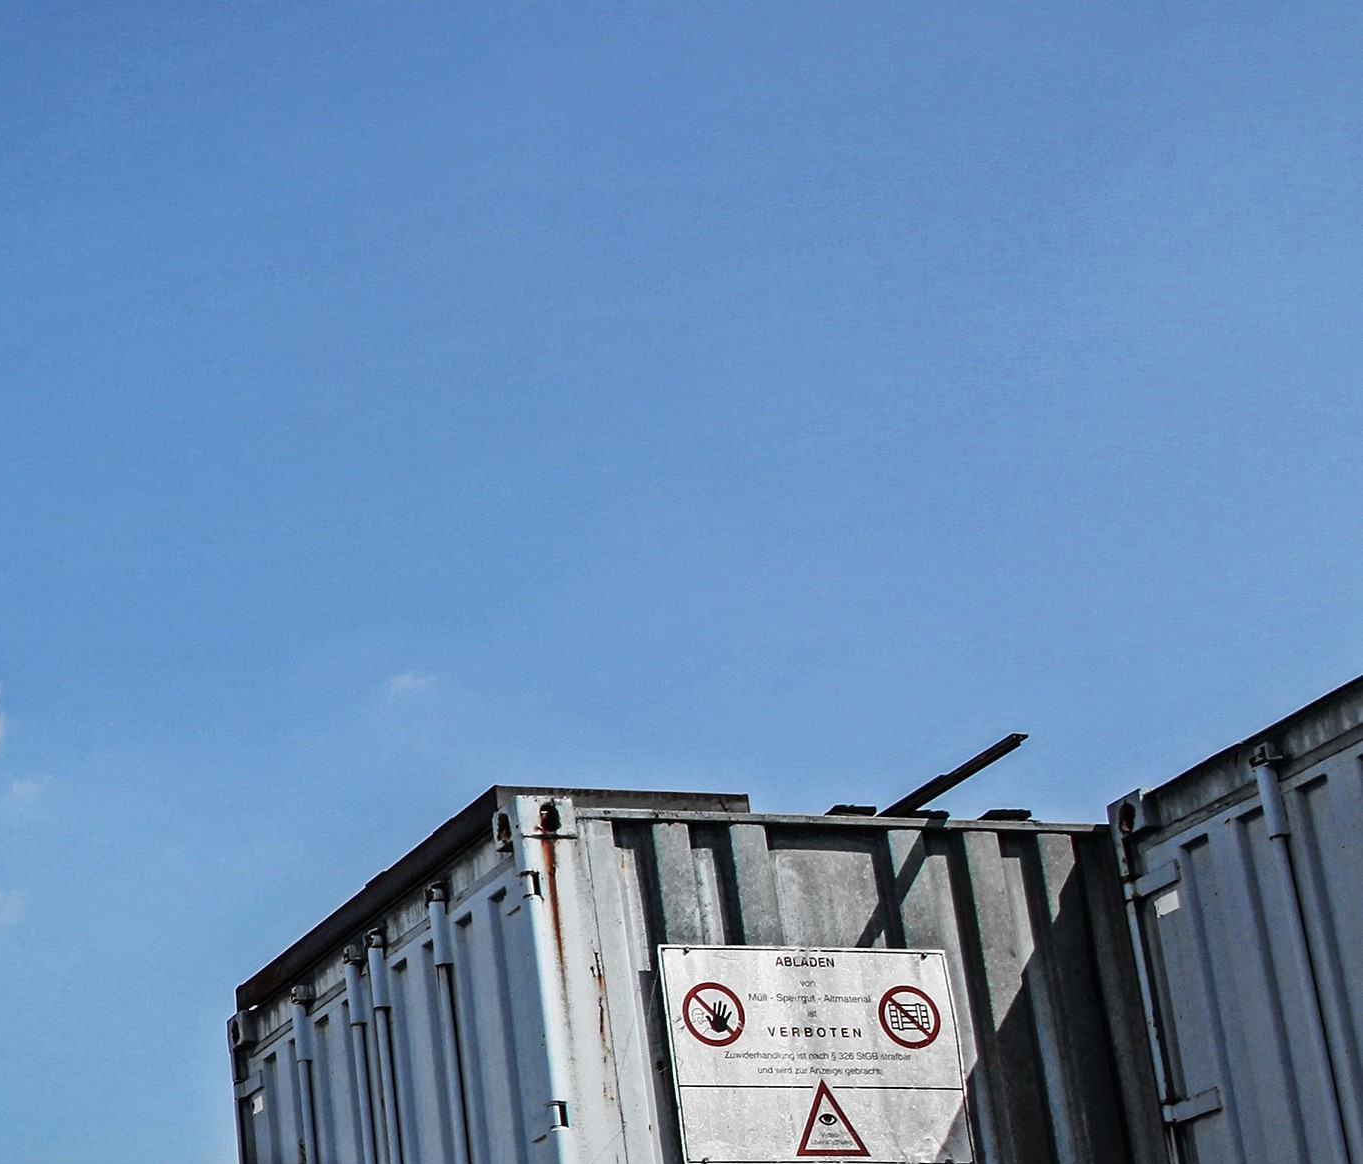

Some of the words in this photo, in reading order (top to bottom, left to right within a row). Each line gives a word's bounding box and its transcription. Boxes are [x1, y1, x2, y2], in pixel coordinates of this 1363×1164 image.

[775, 956, 835, 968] ABLADEN
[748, 993, 767, 1001] Müll
[776, 993, 816, 1004] Sperrgut
[823, 994, 872, 1003] Altmaterial
[807, 1010, 818, 1018] ist
[767, 1026, 862, 1038] VERBOTEN
[796, 1052, 807, 1060] ist
[809, 1052, 829, 1060] nach
[838, 1051, 854, 1060] 326
[856, 1051, 879, 1060] StGB
[881, 1052, 911, 1060] strafbar
[809, 1067, 842, 1076] Anzeige
